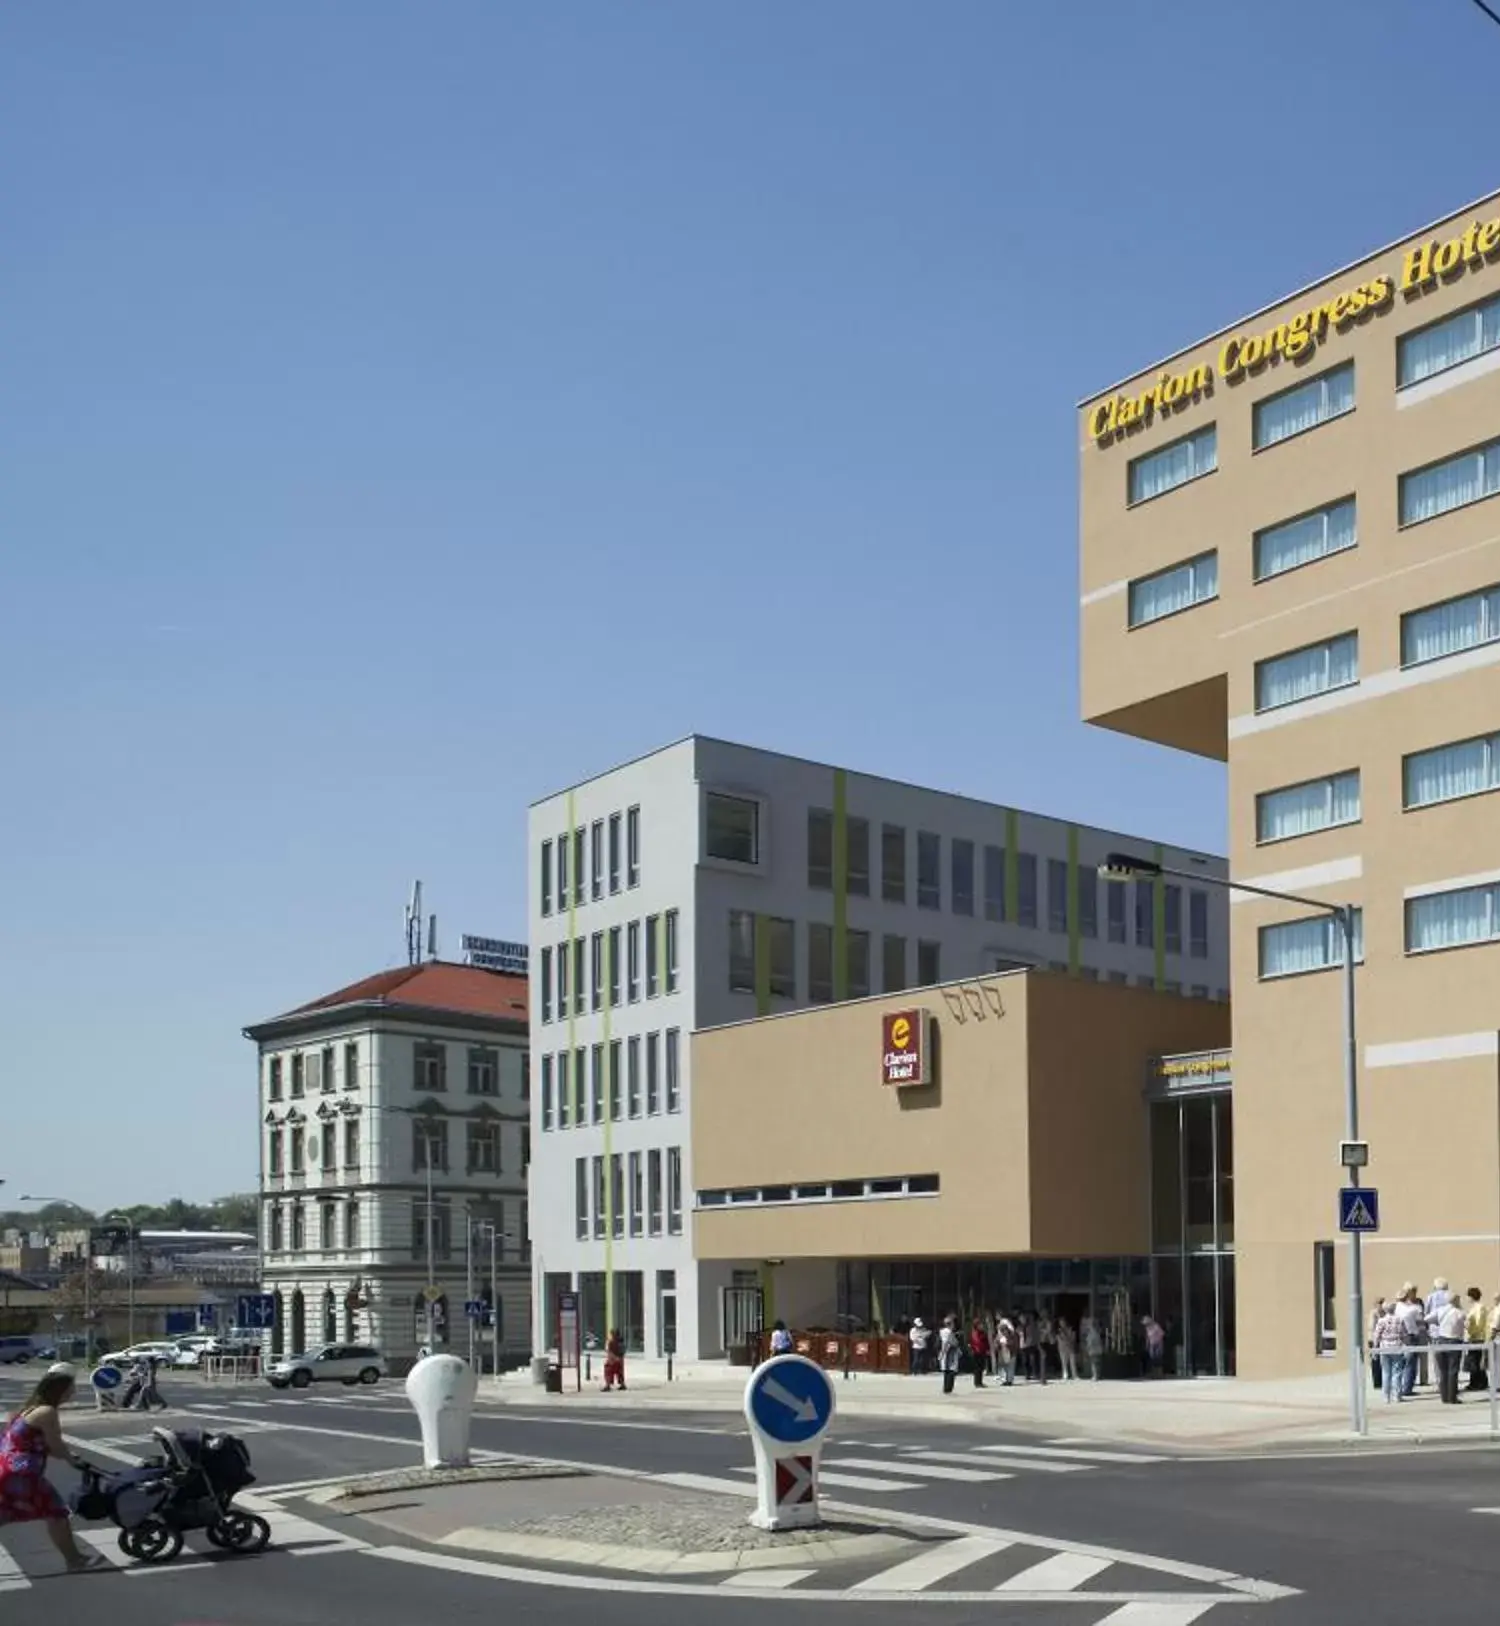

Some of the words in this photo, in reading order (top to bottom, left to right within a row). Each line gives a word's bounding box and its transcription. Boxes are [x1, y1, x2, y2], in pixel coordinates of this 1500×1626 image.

[1088, 361, 1210, 442] Clarion
[1217, 273, 1393, 378] Congress
[883, 1049, 918, 1067] Clarion
[888, 1063, 913, 1079] Hotel
